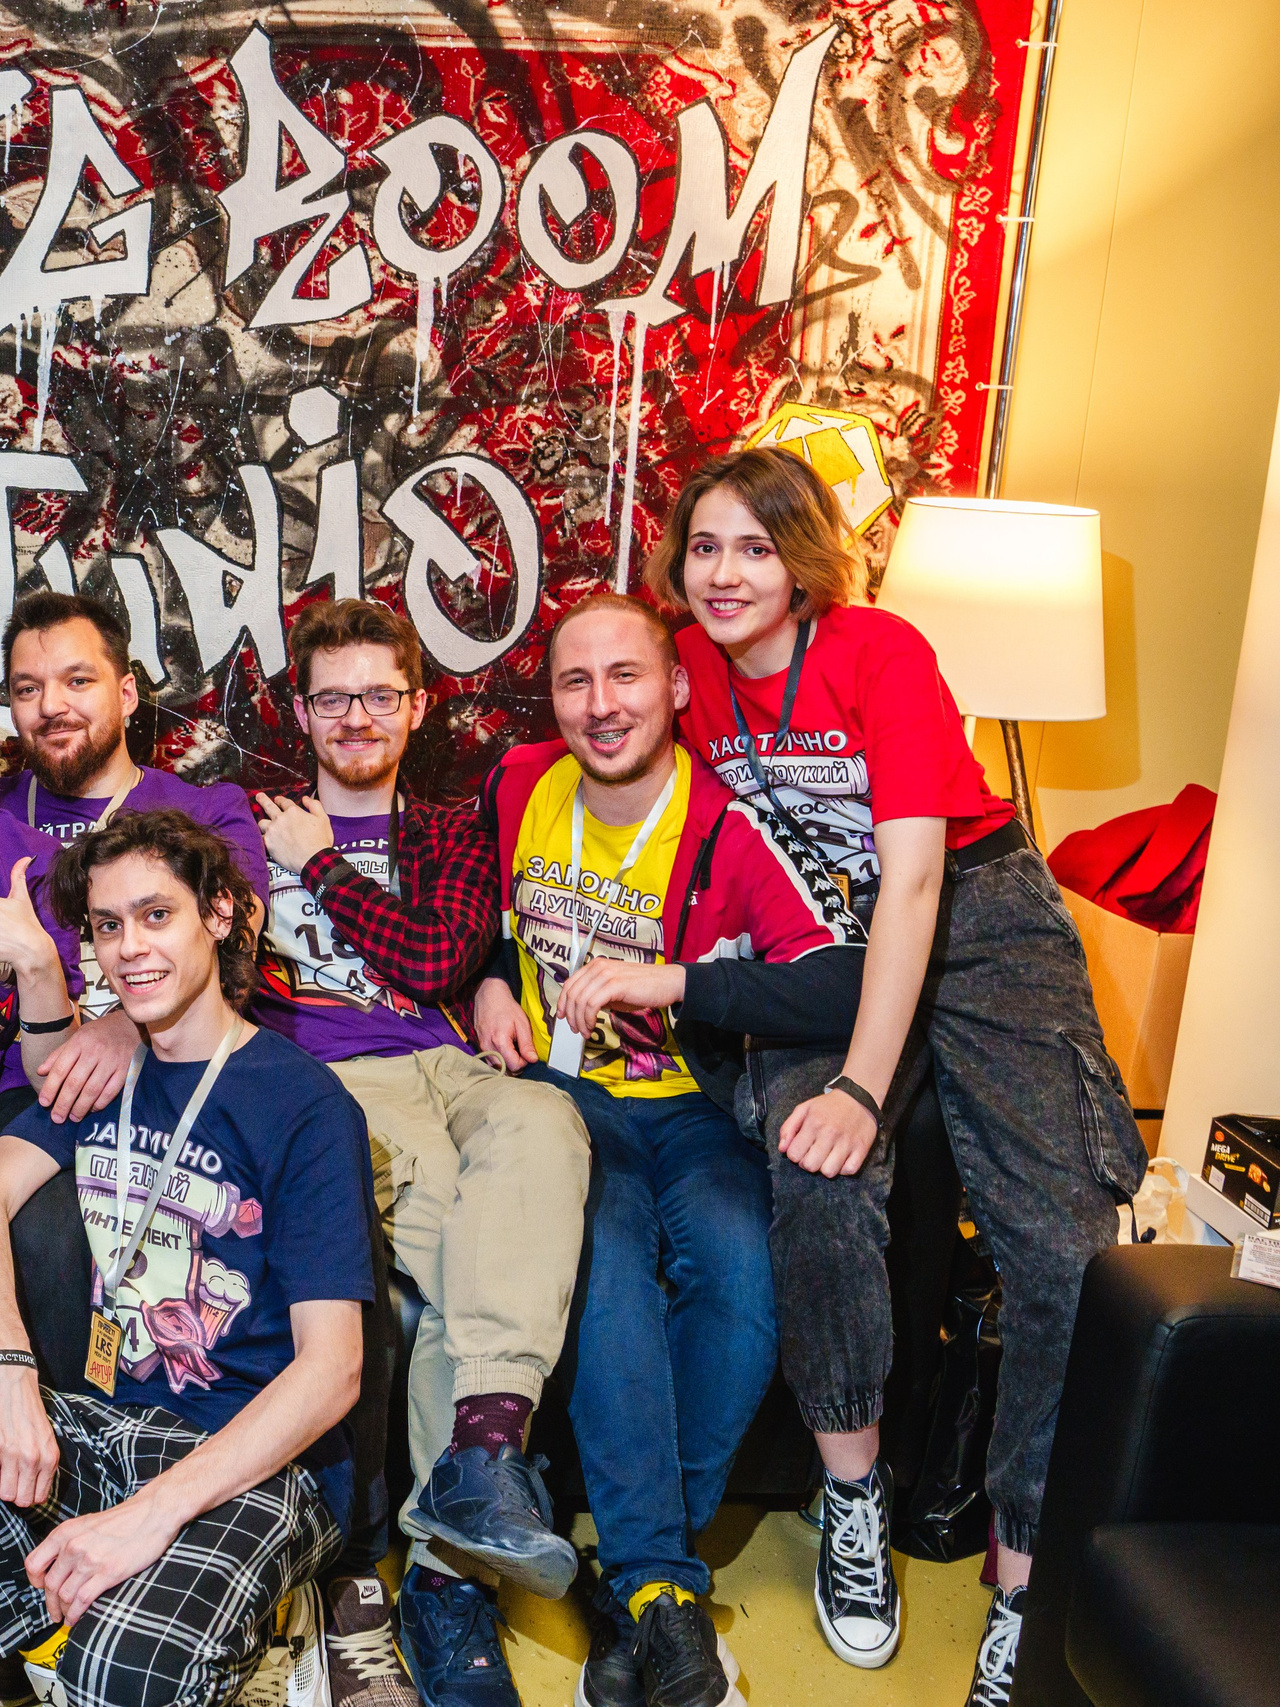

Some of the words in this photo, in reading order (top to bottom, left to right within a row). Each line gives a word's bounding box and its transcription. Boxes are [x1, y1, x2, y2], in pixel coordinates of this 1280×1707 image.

[218, 18, 841, 329] ROOM
[527, 855, 661, 914] ЗАКОННО
[530, 889, 637, 940] ДУШНЫЙ
[1210, 1143, 1231, 1154] MEGA
[90, 1154, 191, 1204] ПЬЯНЙ
[83, 1207, 182, 1250] ИНТЕЛЕКТ
[95, 1334, 113, 1357] LRS
[89, 1361, 113, 1385] АРТУР
[363, 1585, 377, 1593] NIKE
